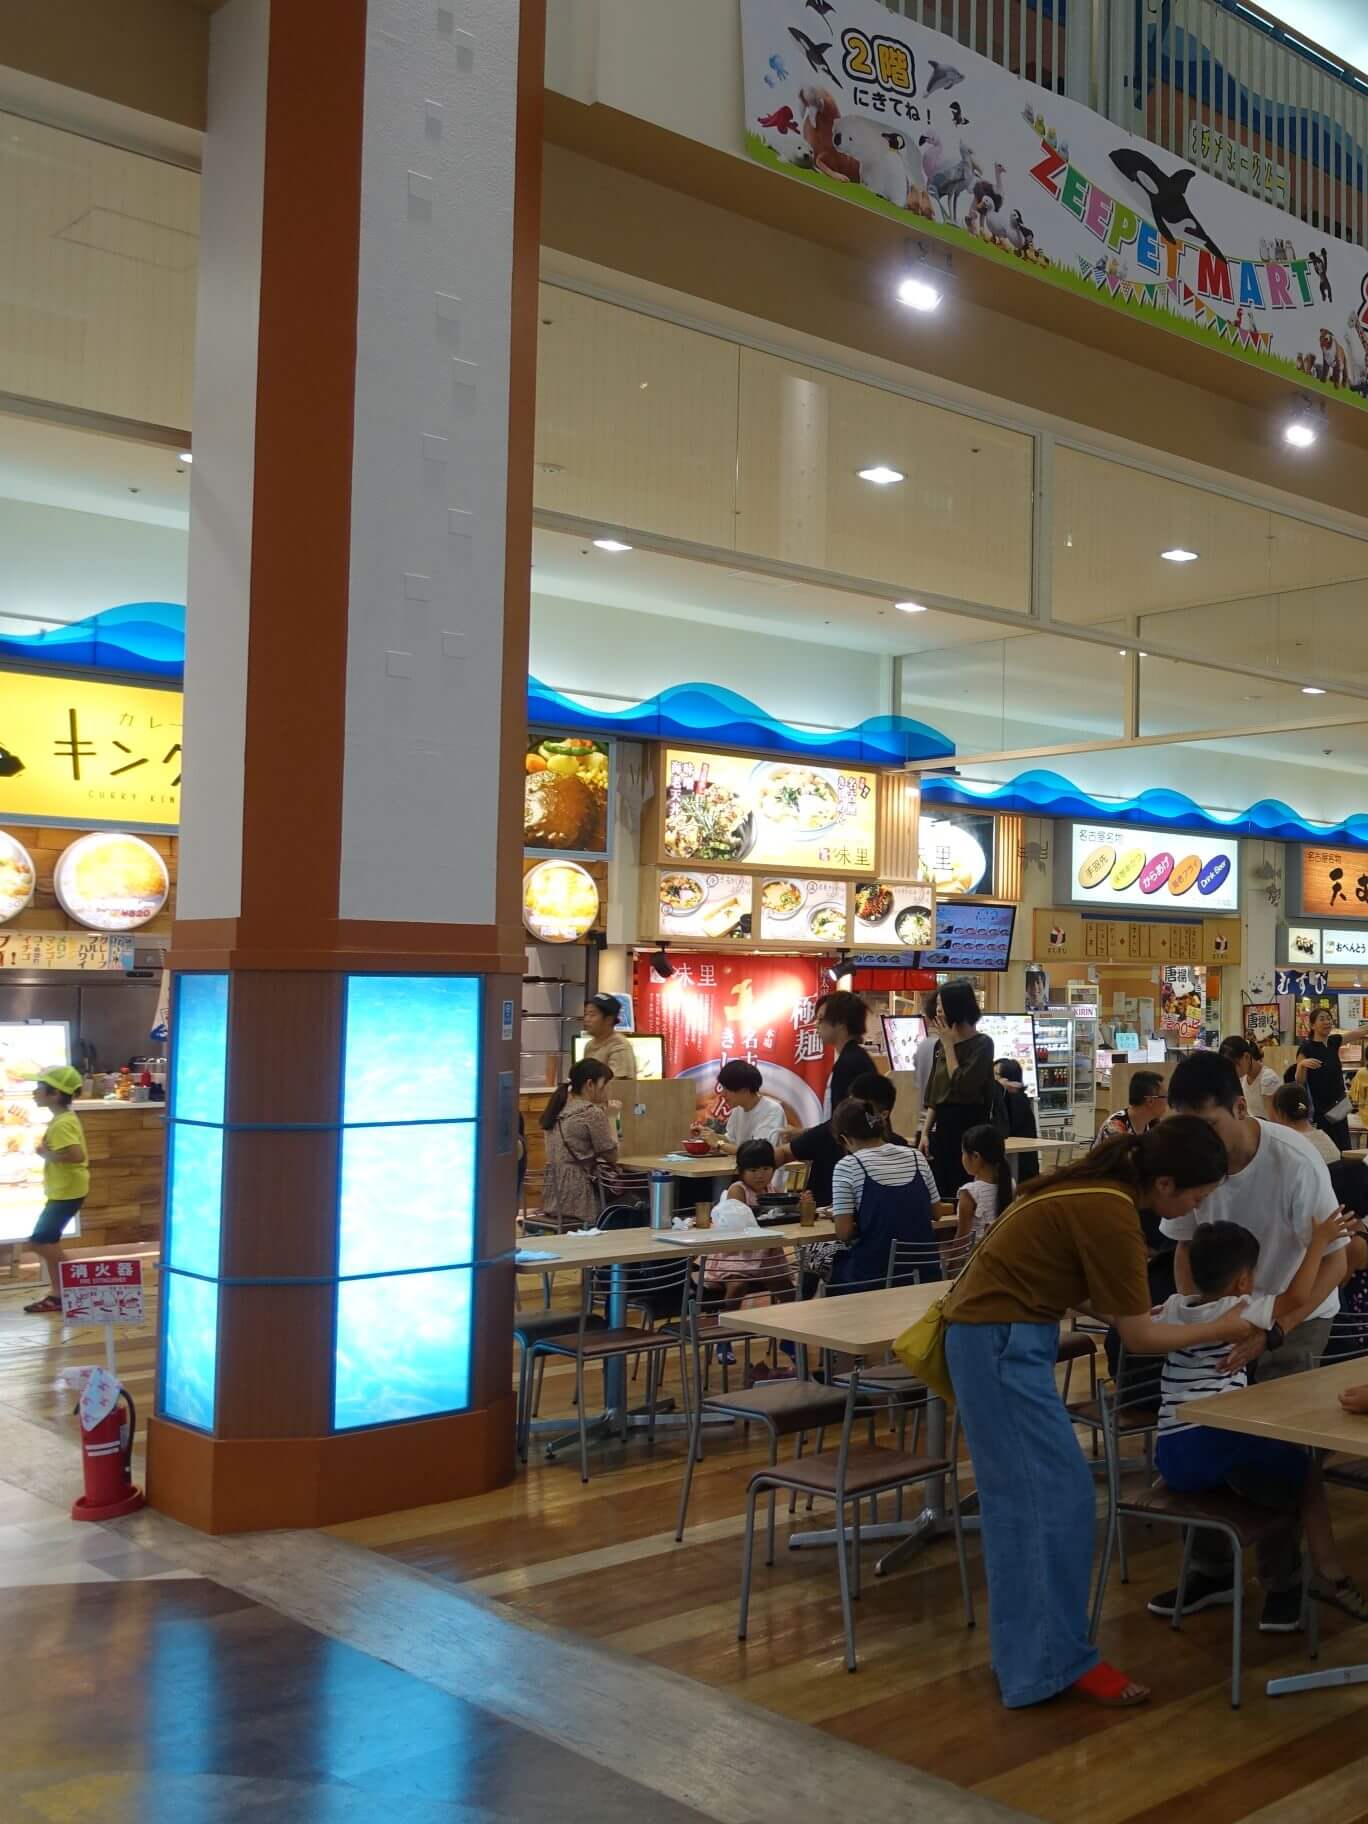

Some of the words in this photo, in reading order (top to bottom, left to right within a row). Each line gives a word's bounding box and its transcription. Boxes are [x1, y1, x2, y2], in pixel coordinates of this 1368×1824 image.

[841, 28, 916, 97] 2階
[1029, 140, 1185, 285] ZEEPET
[1197, 249, 1314, 309] MART
[150, 794, 175, 804] KIN
[1143, 856, 1171, 889] からあげ
[1277, 972, 1327, 996] むすび
[1073, 1007, 1093, 1016] KIRIN
[70, 1262, 133, 1279] 消火器
